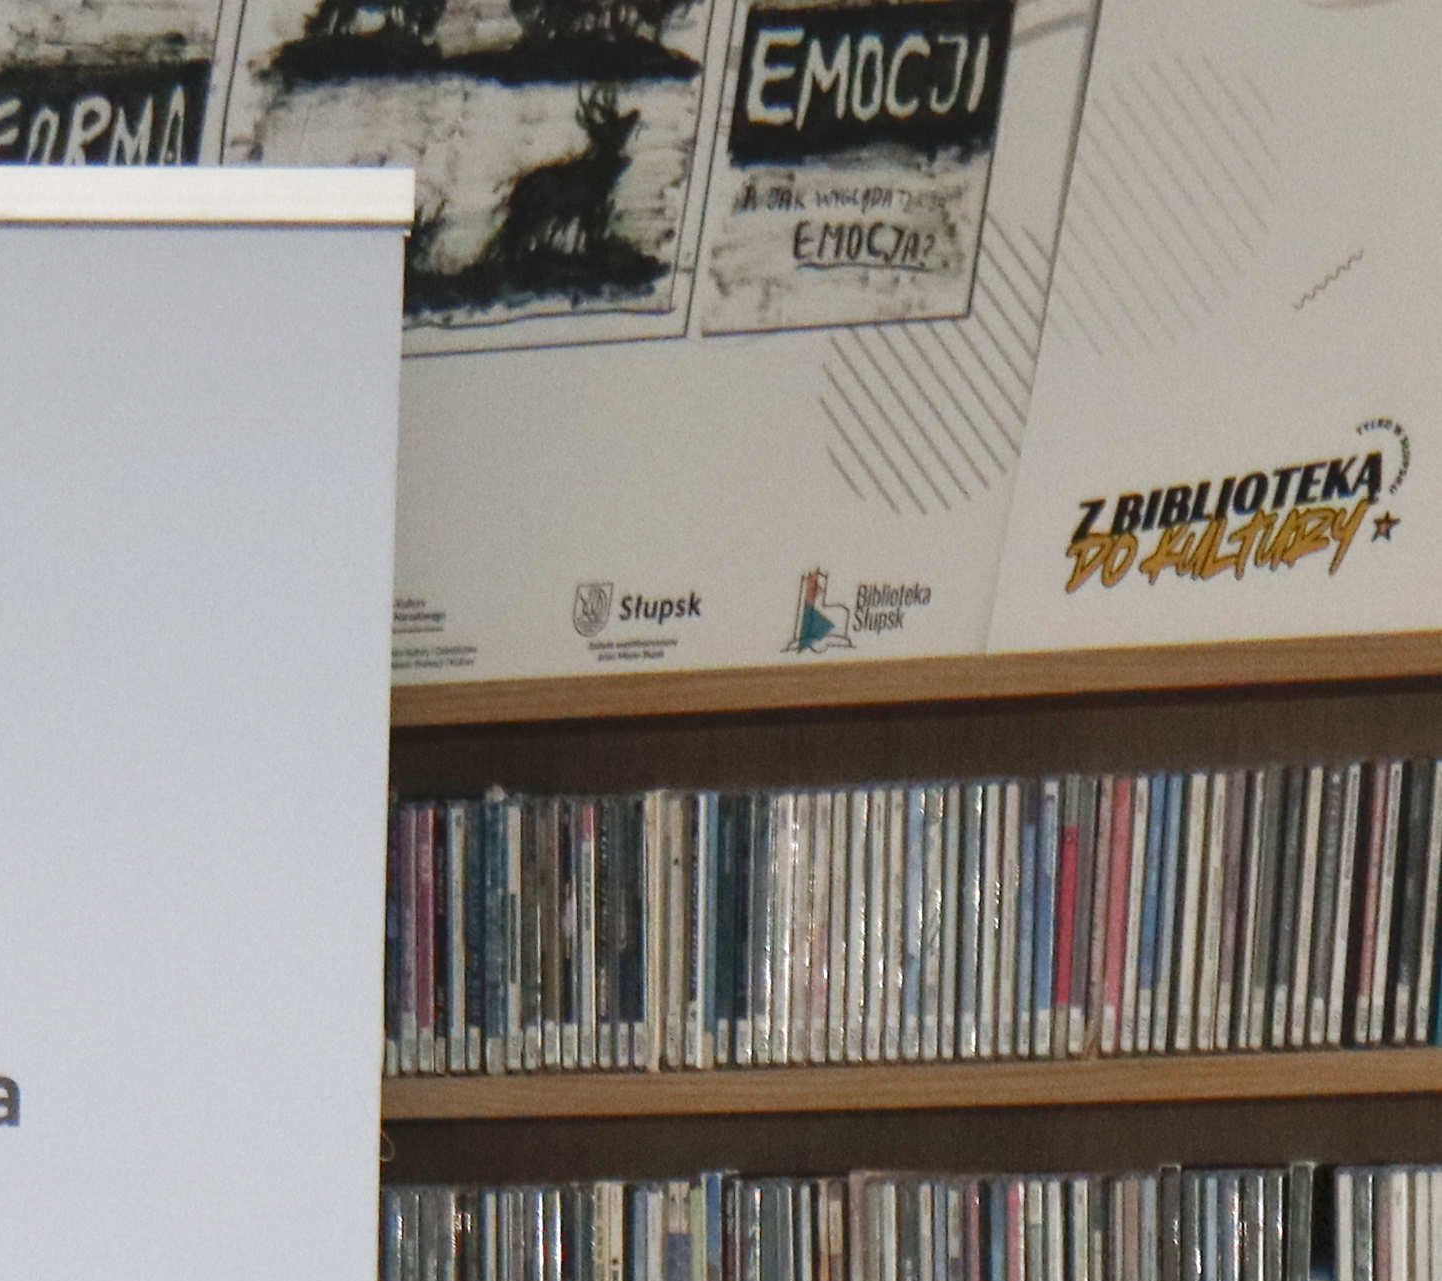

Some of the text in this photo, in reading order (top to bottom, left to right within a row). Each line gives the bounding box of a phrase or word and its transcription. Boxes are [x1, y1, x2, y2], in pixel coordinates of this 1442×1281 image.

[747, 26, 989, 131] EMOCJI
[793, 220, 936, 265] EMOCJA?
[1065, 500, 1372, 594] DO KULTURY
[1070, 499, 1106, 548] Z
[619, 590, 702, 624] Słupsk
[855, 582, 932, 610] Biblioteka
